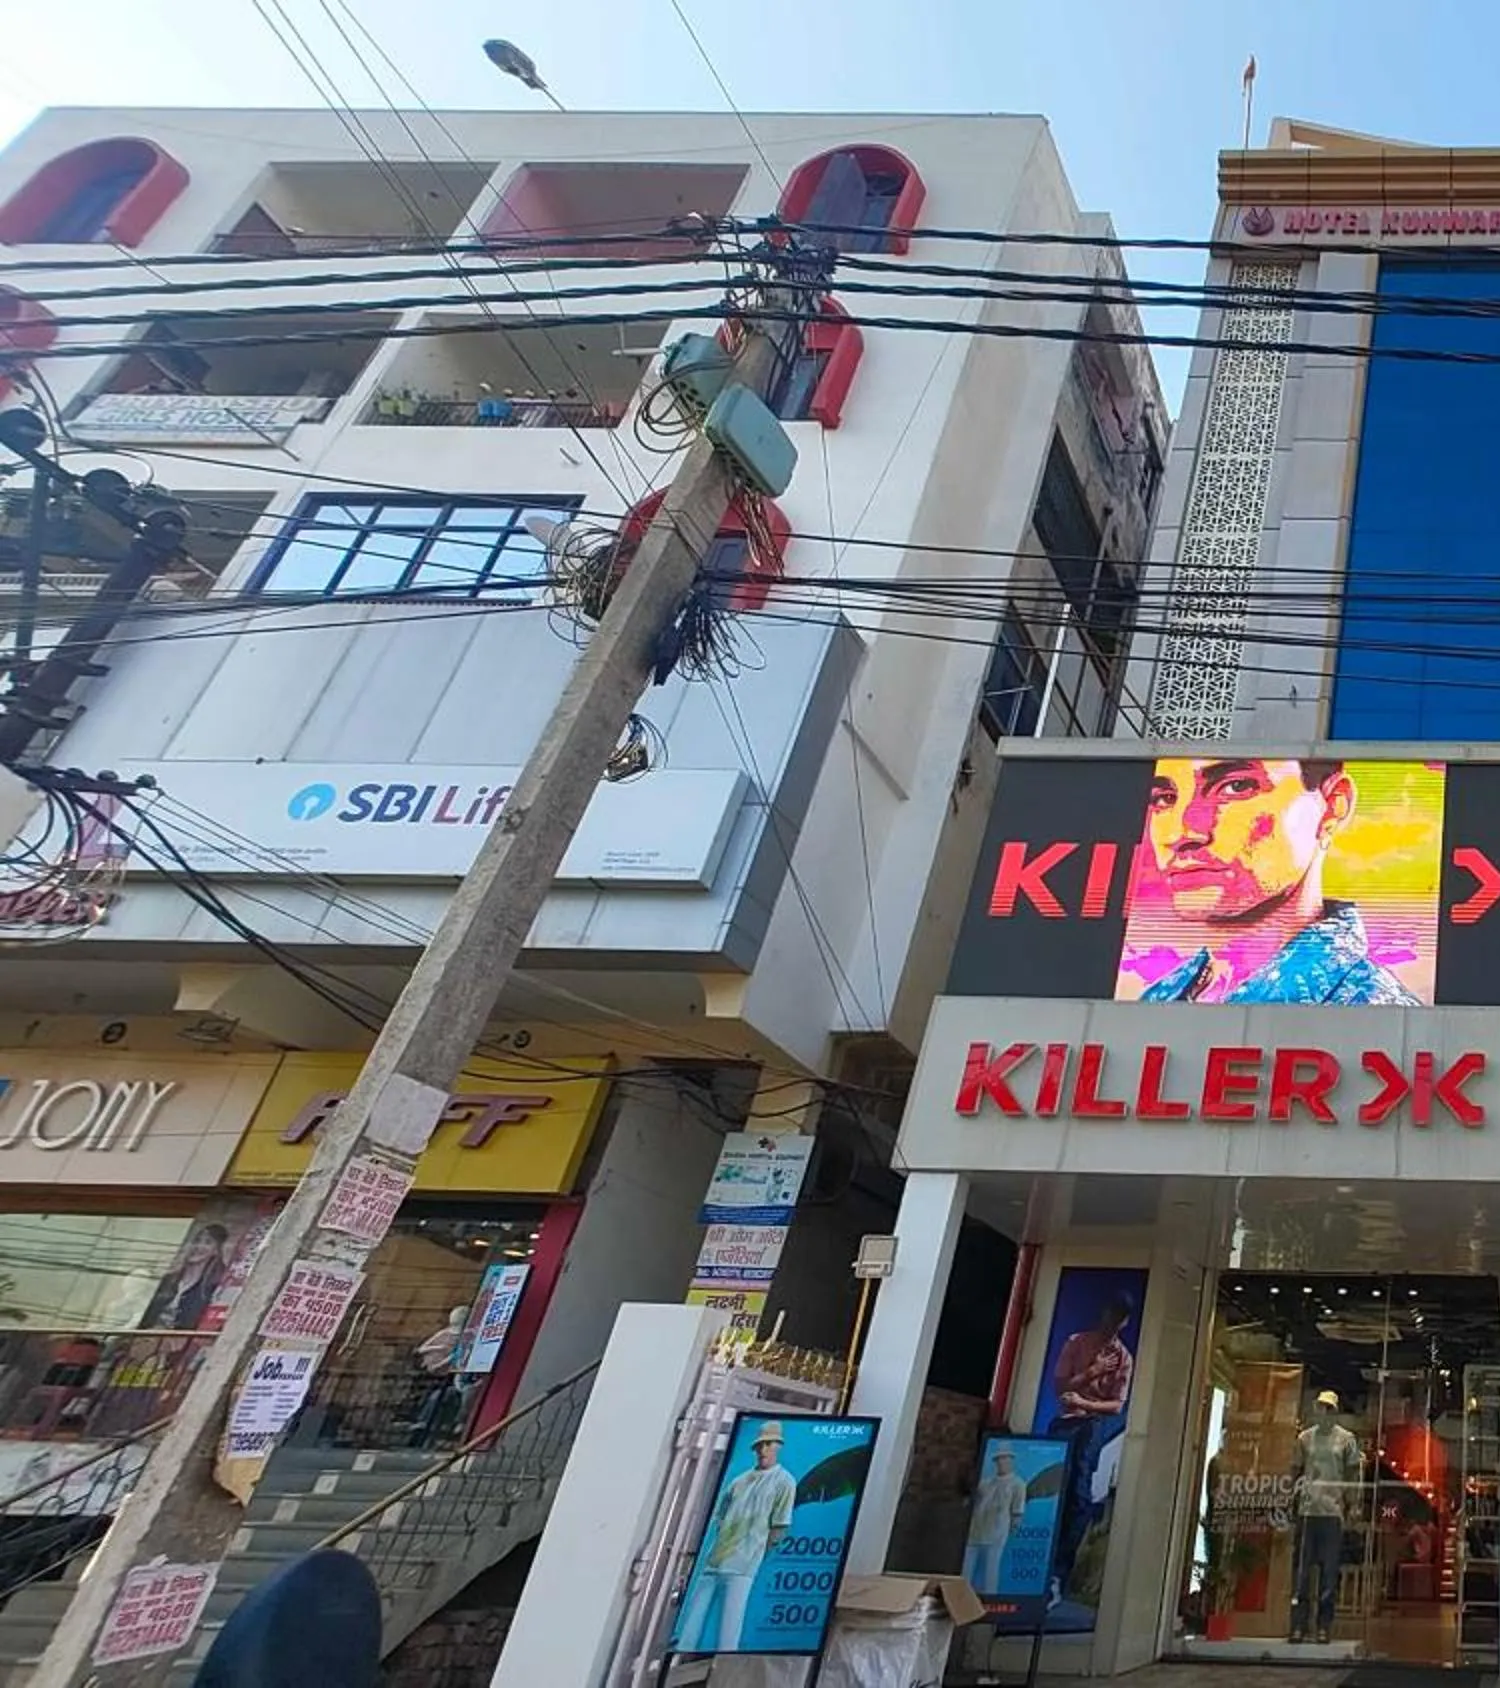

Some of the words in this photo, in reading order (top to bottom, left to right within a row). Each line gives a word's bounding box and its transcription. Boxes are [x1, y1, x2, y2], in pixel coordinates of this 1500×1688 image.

[1284, 206, 1370, 235] HOTEL
[338, 783, 436, 824] SBI
[432, 786, 512, 825] Lif
[954, 1041, 1343, 1125] KILLER
[778, 1536, 843, 1556] 2000
[772, 1571, 834, 1592] 1000
[769, 1604, 819, 1625] 500
